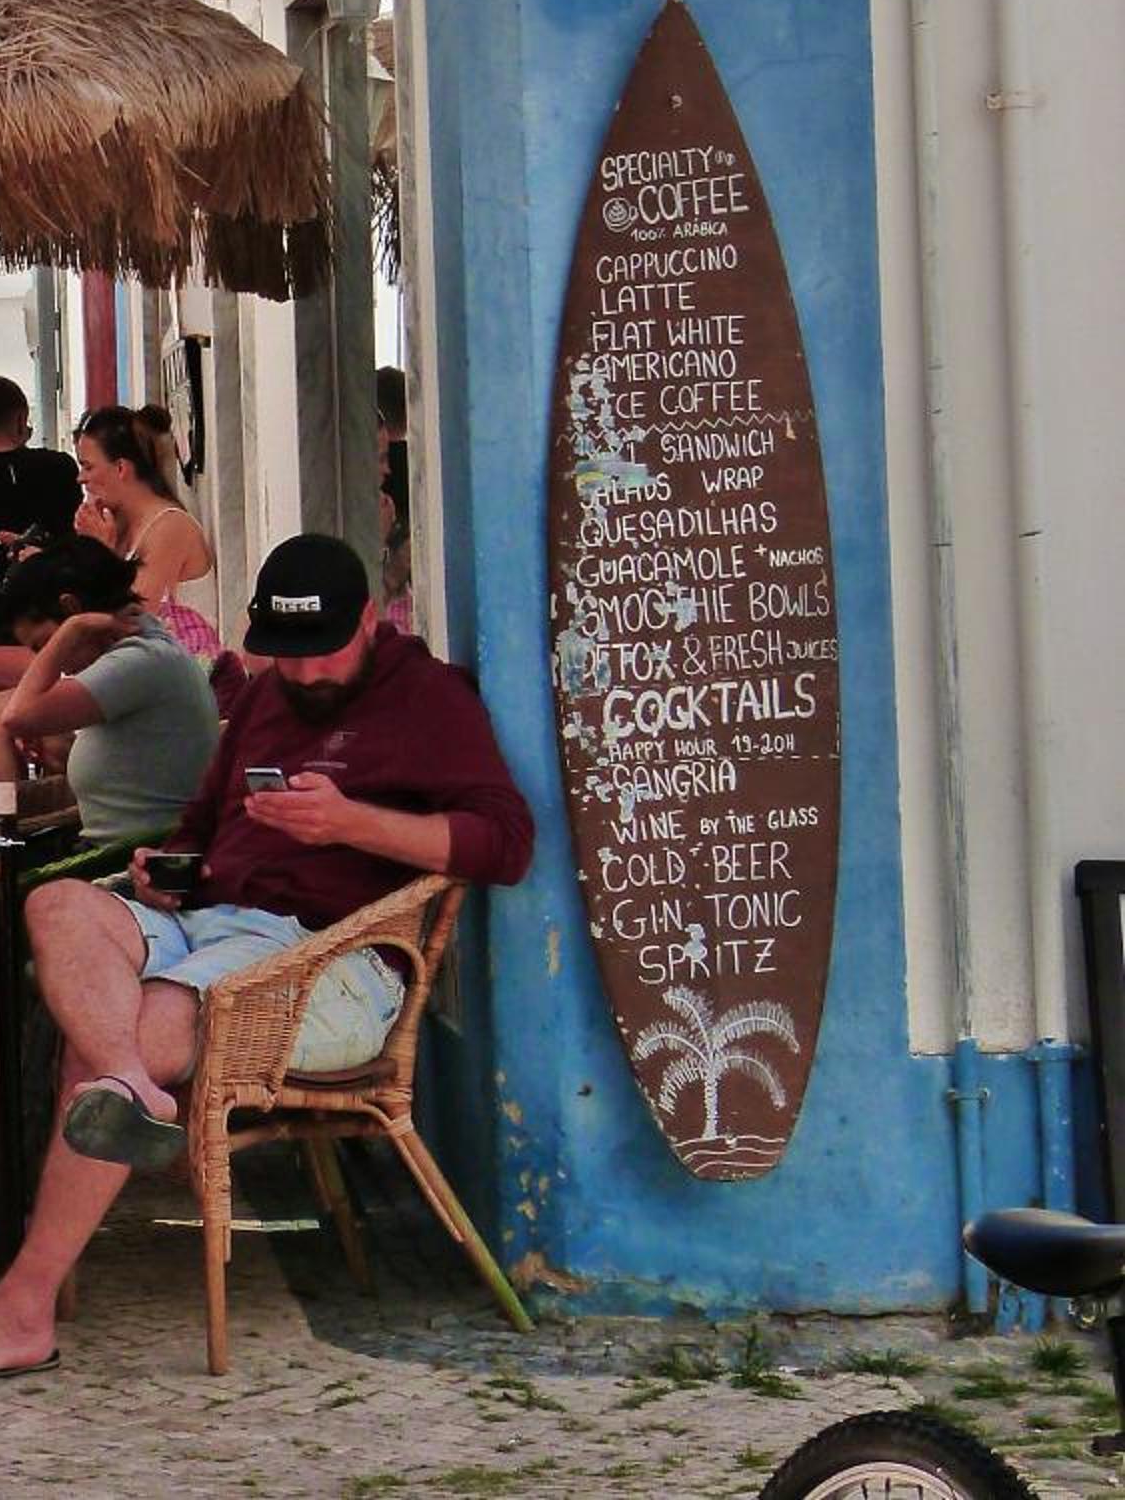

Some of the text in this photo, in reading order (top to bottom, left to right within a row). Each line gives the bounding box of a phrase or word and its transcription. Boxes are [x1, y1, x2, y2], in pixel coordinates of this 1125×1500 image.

[600, 145, 713, 192] SPECIALTY
[638, 173, 749, 225] COFFEE
[630, 227, 666, 242] 100%
[596, 244, 738, 284] CAPPUCCINO
[600, 282, 696, 315] LATTE
[592, 315, 745, 352] FLAT WHITE
[592, 349, 737, 382] AMERICANO
[660, 379, 763, 416] COFFEE
[660, 429, 775, 464] SANDWICH
[701, 465, 764, 494] WRAP
[580, 501, 778, 548] QUESADILHAS
[575, 544, 747, 588] GUACAMOLE
[769, 546, 824, 568] NACHOS
[748, 580, 830, 622] BOWLS
[682, 634, 708, 676] &
[708, 628, 784, 671] FRESH
[786, 638, 838, 662] JUICES
[602, 672, 817, 736] COCKTAILS
[609, 731, 795, 762] HAPPY HOUR 19-20H
[612, 758, 737, 803] SANGRIA
[610, 805, 819, 845] WINE BY THE GLASS
[602, 841, 793, 893] COLD BEER
[612, 889, 802, 940] GIN TONIC
[638, 938, 778, 984] SPRITZ
